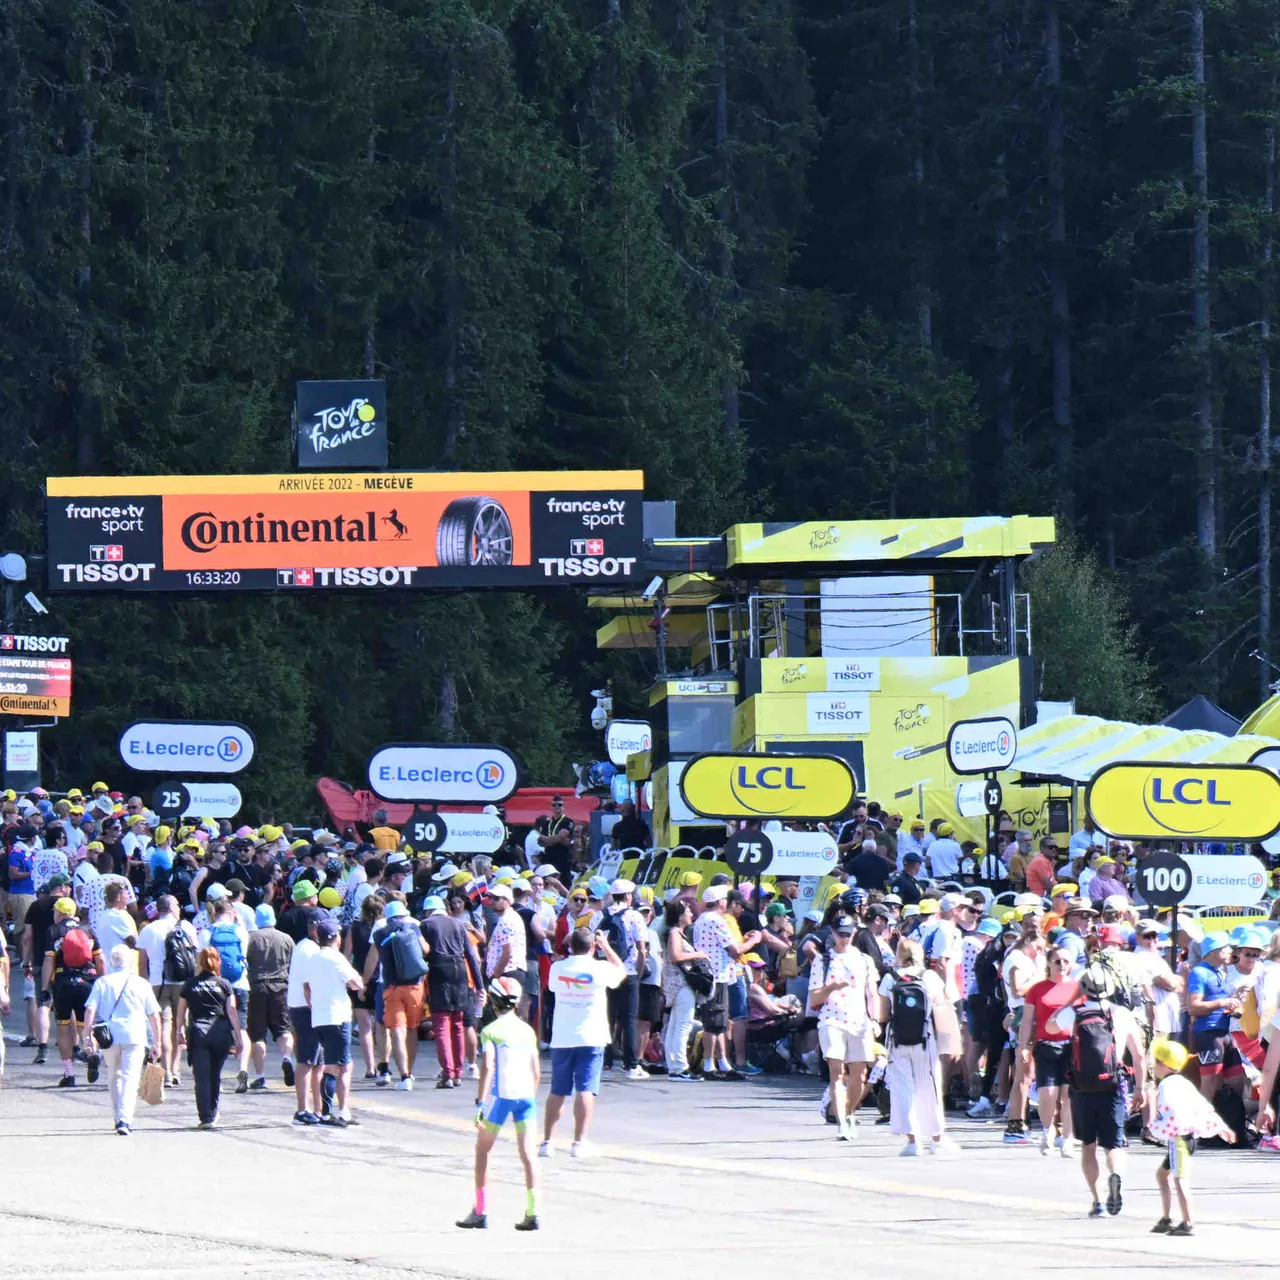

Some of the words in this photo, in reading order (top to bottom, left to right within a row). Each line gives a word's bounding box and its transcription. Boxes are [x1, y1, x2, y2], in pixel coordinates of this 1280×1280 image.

[278, 477, 325, 492] ARRIVÉE
[328, 477, 354, 491] 2022
[363, 475, 414, 490] MEGÈVE
[101, 518, 144, 535] sport
[582, 513, 625, 530] sport
[181, 511, 378, 554] Continental
[57, 563, 156, 583] TISSOT
[538, 557, 637, 577] TISSOT
[185, 571, 241, 586] 16:33:20
[314, 565, 418, 587] TISSOT
[13, 635, 70, 653] TISSOT
[834, 671, 874, 680] TISSOT
[0, 695, 50, 711] Continental
[815, 711, 863, 721] TISSOT
[129, 740, 215, 757] E.Leclerc
[954, 740, 997, 755] E.Leclerc
[379, 766, 474, 784] E.Leclerc
[737, 765, 806, 790] LCL
[162, 791, 181, 808] 25
[988, 788, 999, 805] 25
[1151, 778, 1232, 806] LCL
[414, 823, 438, 841] 50
[737, 842, 762, 863] 75
[777, 849, 821, 859] E.Leclerc
[1141, 867, 1187, 893] 100
[1196, 875, 1247, 886] E.Leclerc
